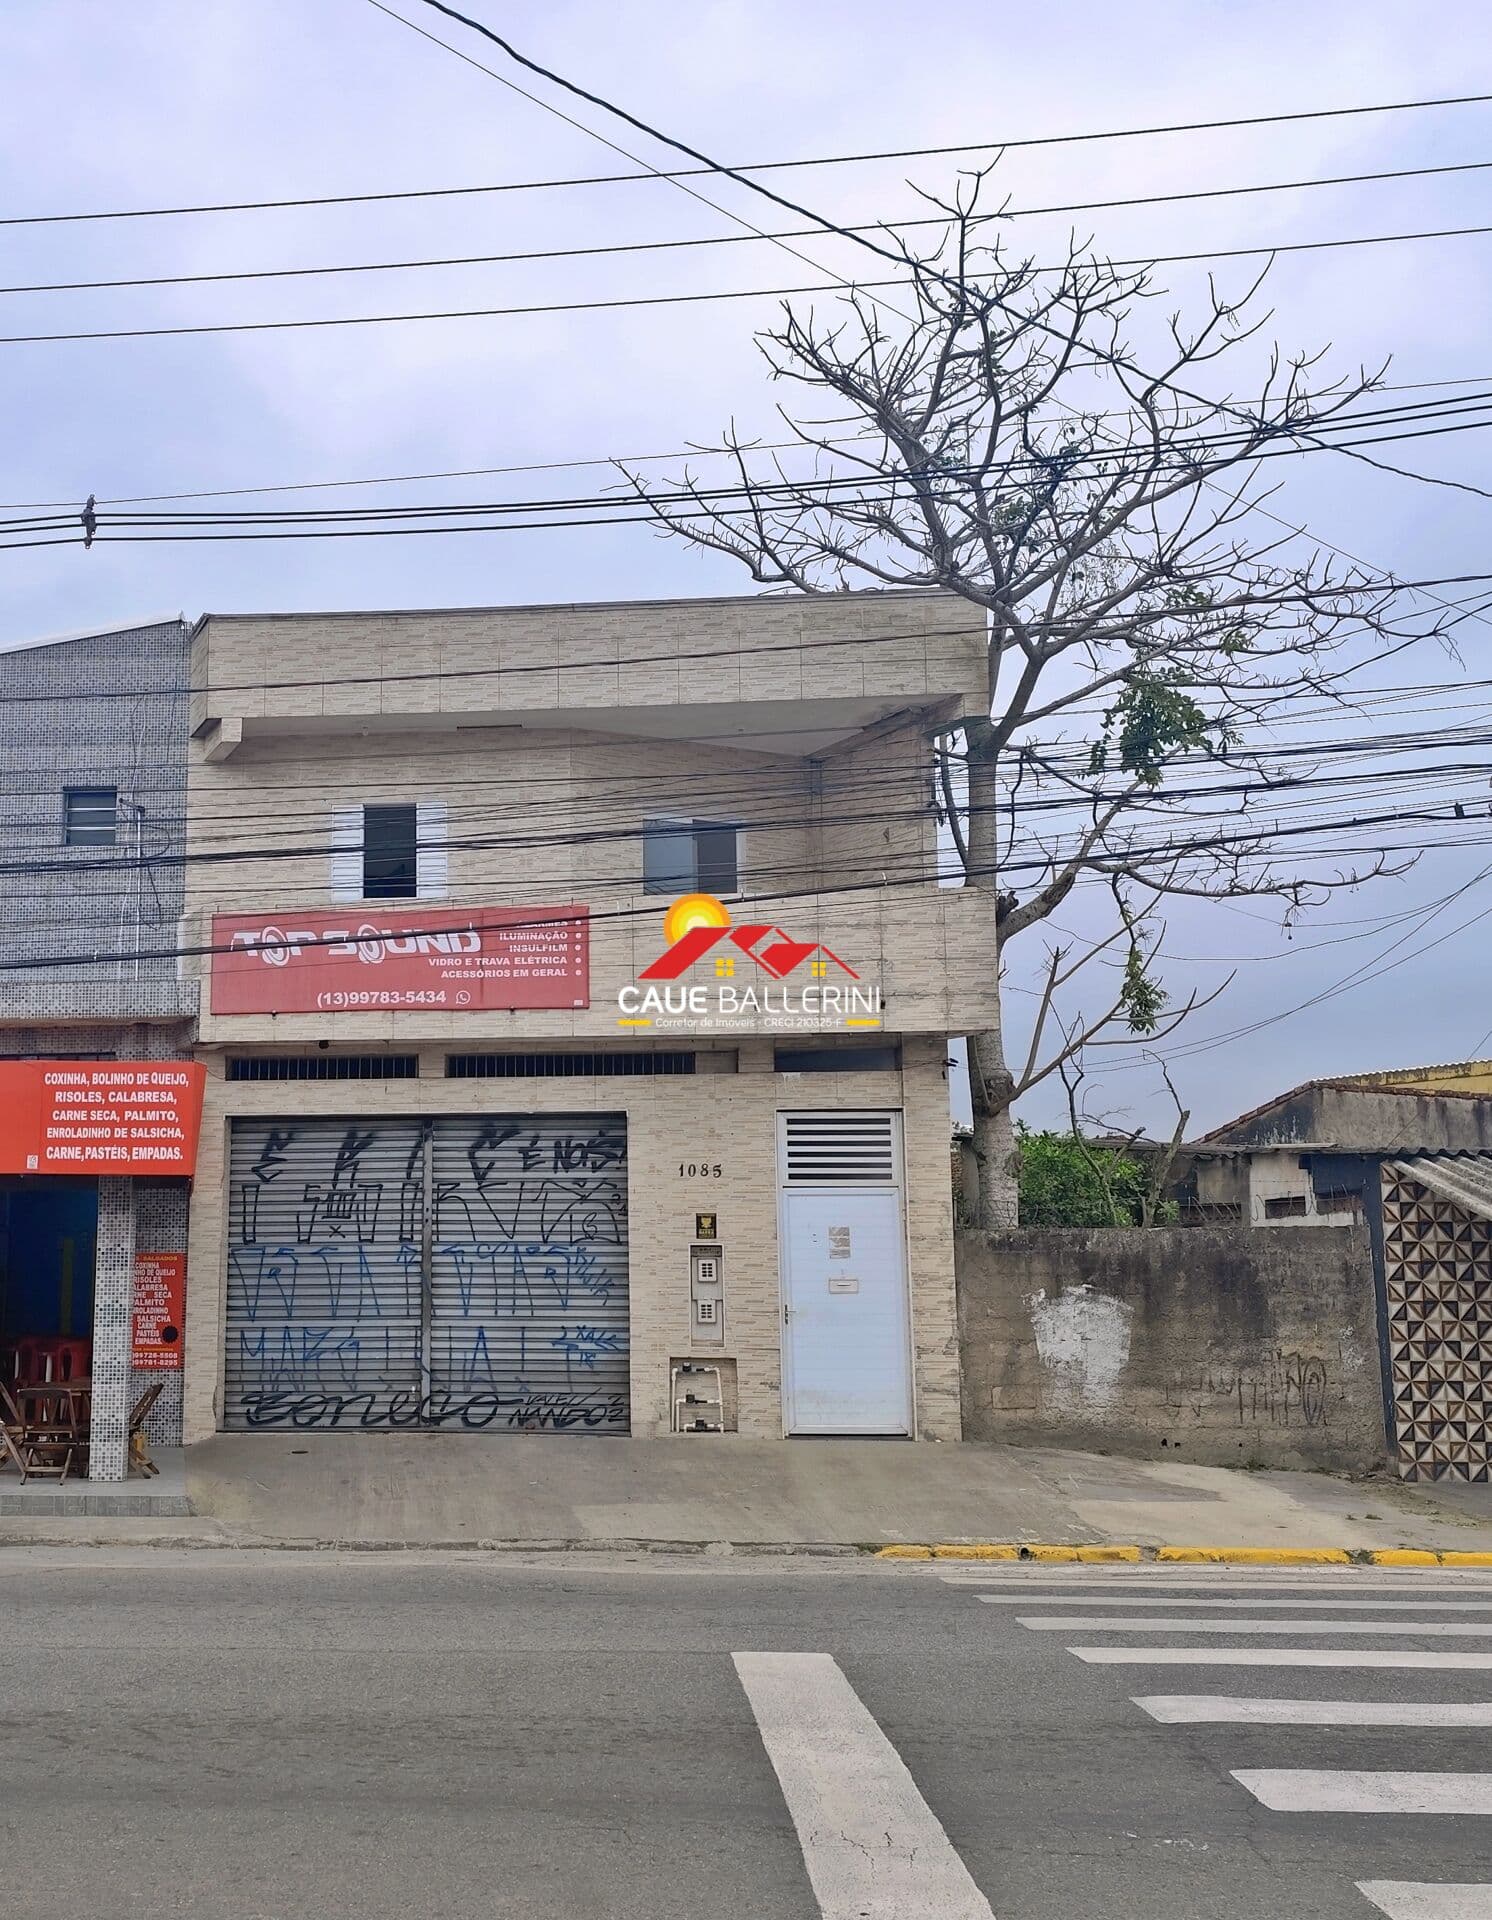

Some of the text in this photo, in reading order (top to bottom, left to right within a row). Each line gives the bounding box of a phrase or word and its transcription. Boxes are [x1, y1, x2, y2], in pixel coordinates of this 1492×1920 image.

[499, 930, 568, 942] ILUMINAÇÃO
[233, 924, 482, 966] TOP SOUND
[509, 943, 568, 953] INSULFILM
[428, 955, 568, 967] VIDRO E TRAVA ELÉTRICA
[440, 968, 568, 979] ACESSÓRIOS EM GERAL
[317, 990, 447, 1009] (13)99783-5434
[45, 1072, 189, 1087] COXINHA, BOLINHO DE QUEIJO,
[55, 1091, 178, 1104] RISOLES, CALABRESA,
[52, 1110, 179, 1123] CARNE SECA, PALMITO,
[47, 1127, 185, 1140] ENROLADINHO DE SALSICHA,
[132, 1146, 183, 1160] EMPADAS.
[679, 1163, 722, 1178] 1085
[153, 1291, 172, 1299] SECA
